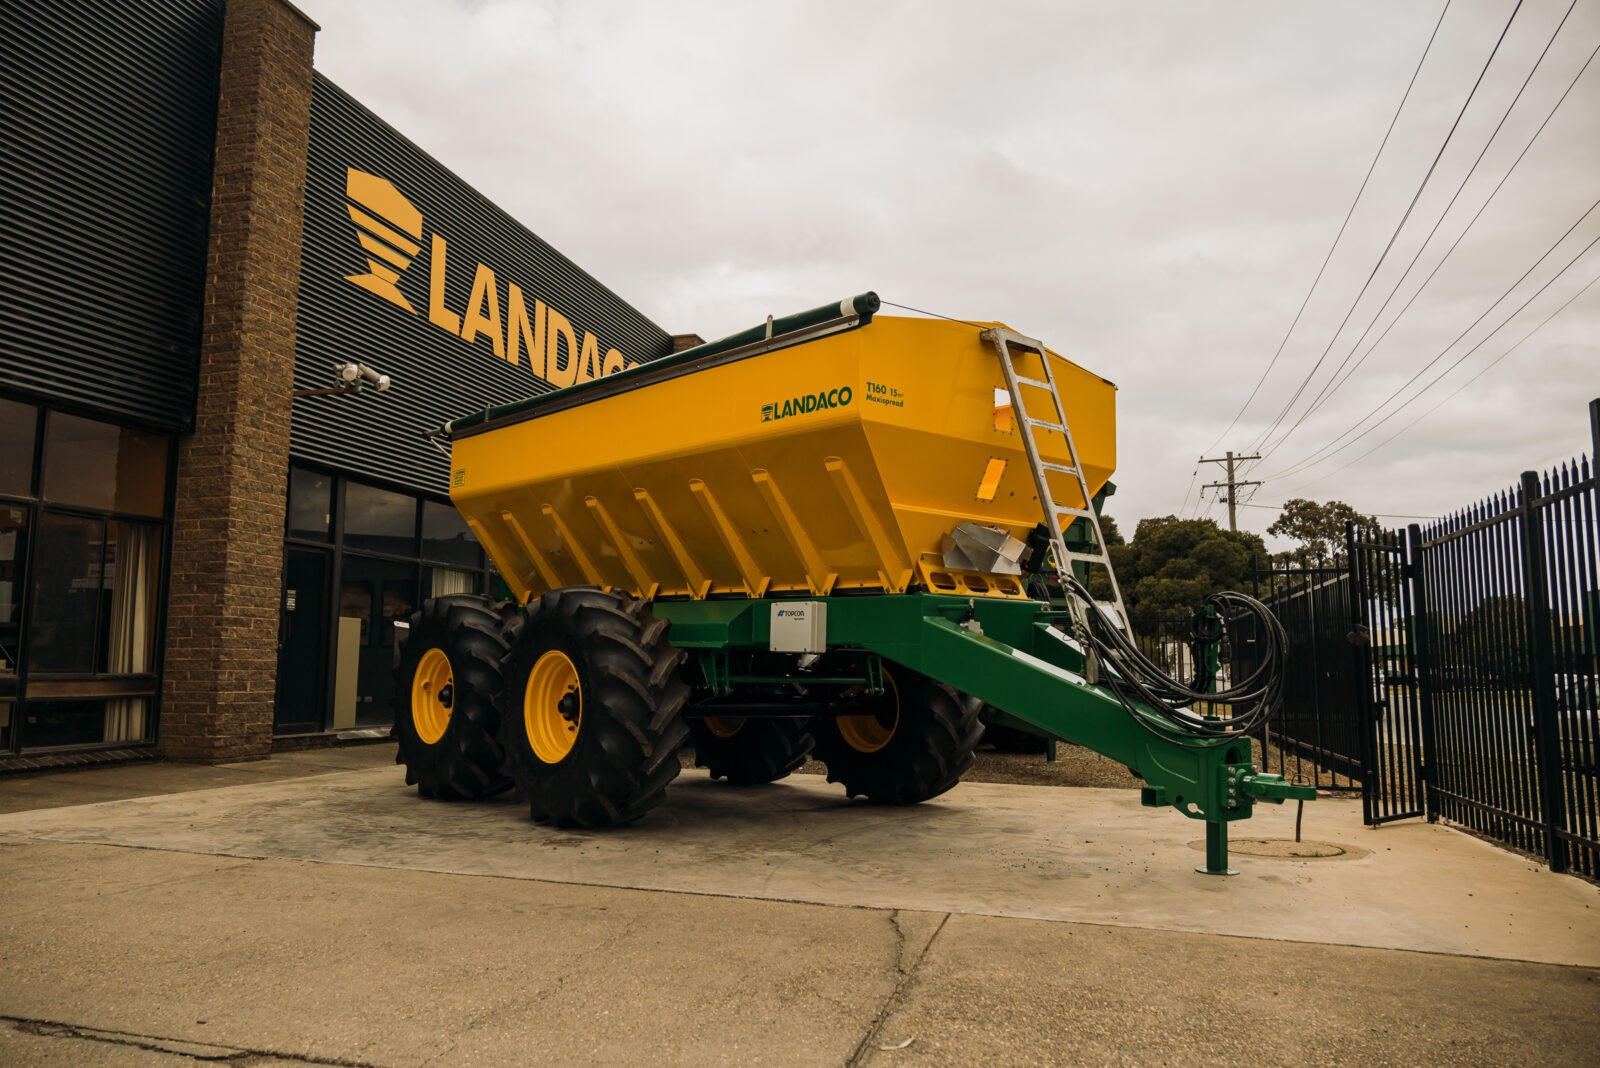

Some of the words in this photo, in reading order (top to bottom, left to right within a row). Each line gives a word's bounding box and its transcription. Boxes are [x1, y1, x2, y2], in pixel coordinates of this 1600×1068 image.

[428, 232, 640, 389] LANDA
[866, 382, 887, 395] T160
[774, 386, 852, 420] LANDACO
[866, 394, 904, 407] Maxispread
